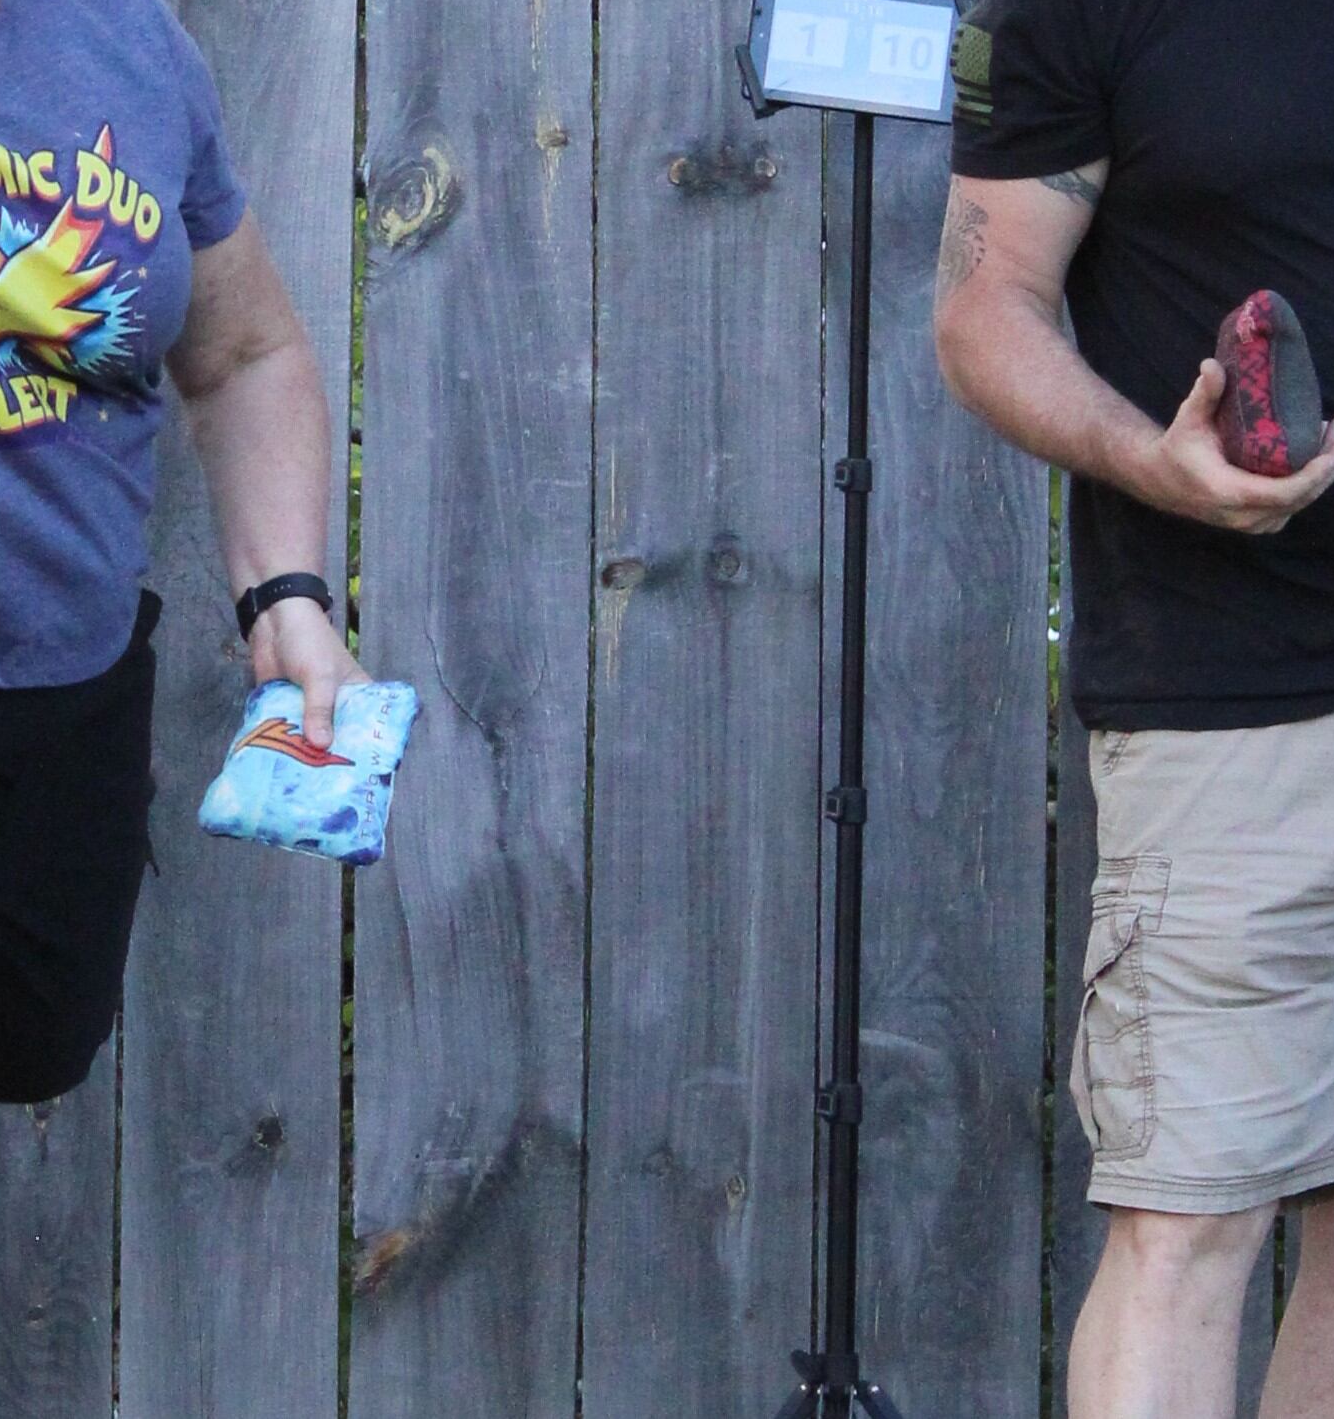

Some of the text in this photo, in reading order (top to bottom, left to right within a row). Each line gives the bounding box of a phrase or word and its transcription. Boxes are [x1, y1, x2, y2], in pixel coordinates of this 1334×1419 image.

[799, 22, 818, 58] 1
[883, 33, 933, 71] 10
[77, 149, 163, 242] DUO
[374, 692, 399, 740] FIRE
